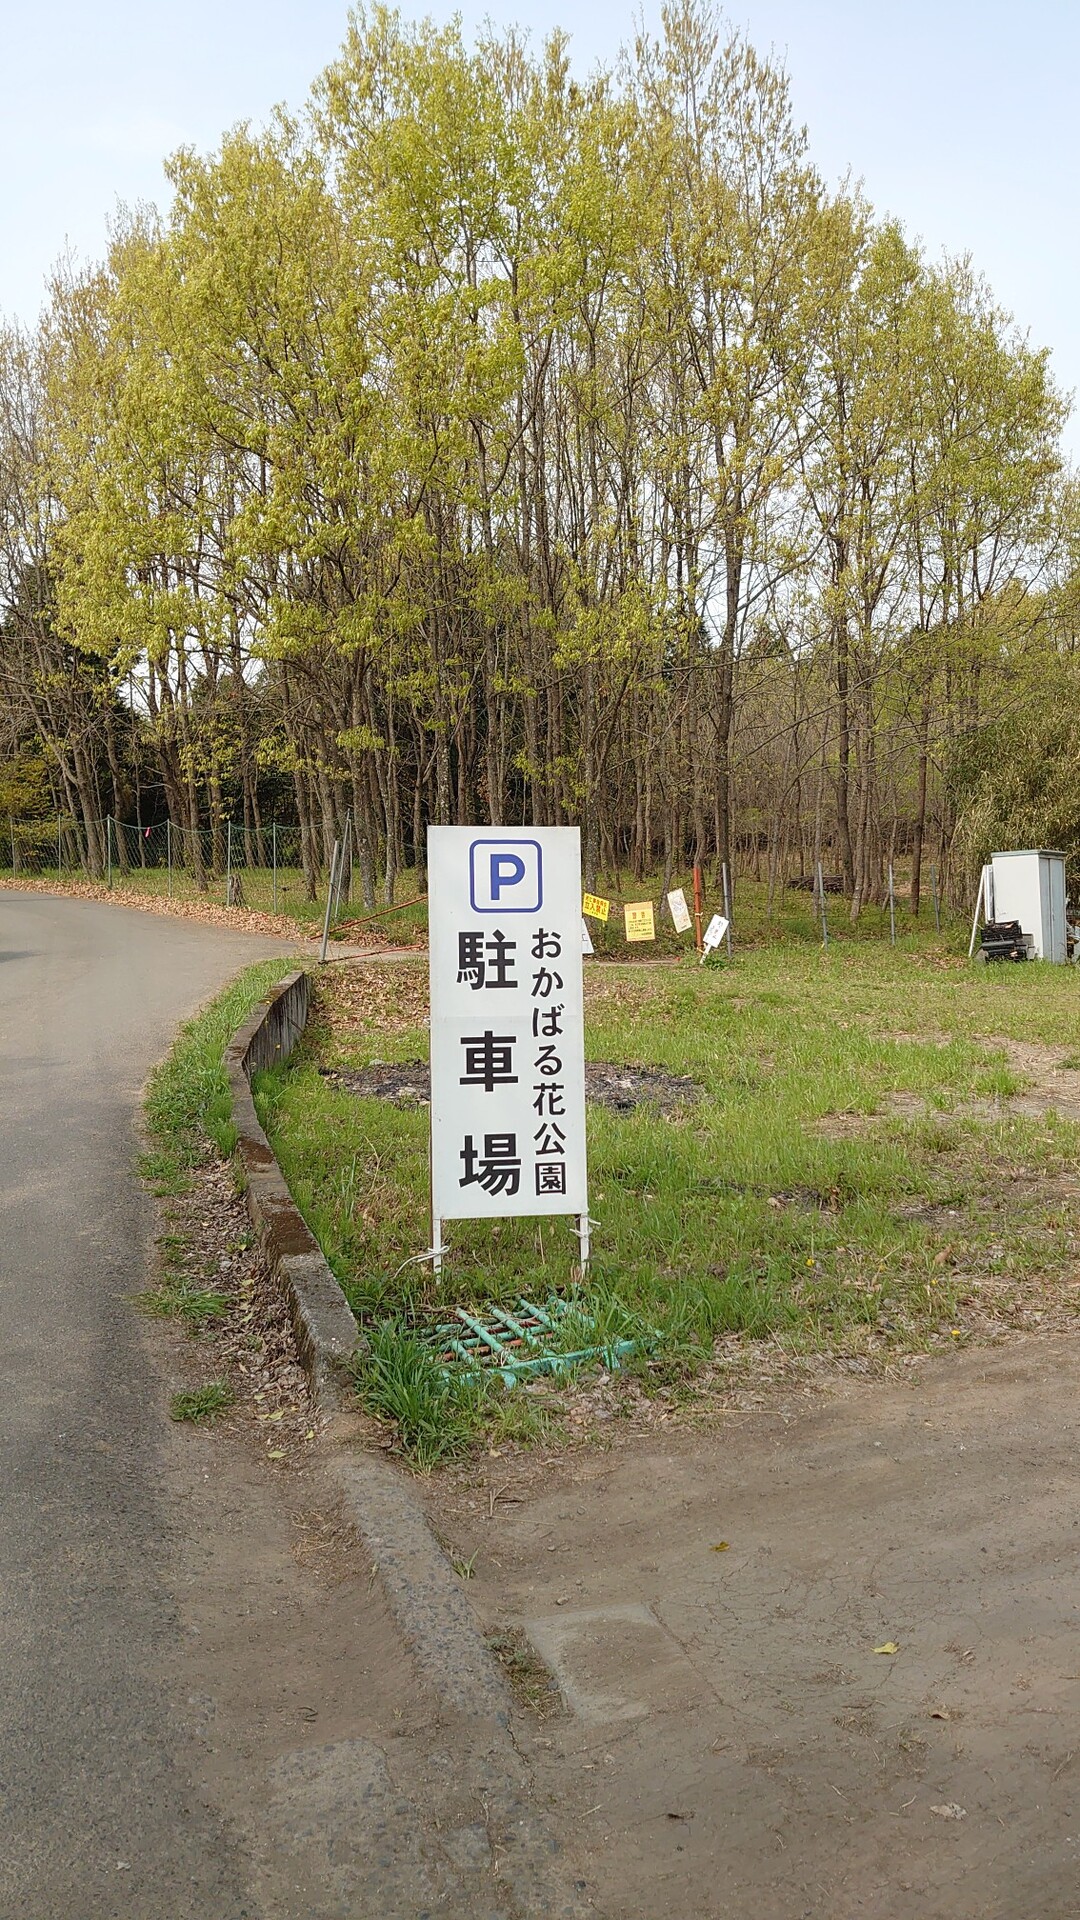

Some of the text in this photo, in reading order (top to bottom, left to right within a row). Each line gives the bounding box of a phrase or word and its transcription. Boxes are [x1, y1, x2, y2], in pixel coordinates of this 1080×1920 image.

[491, 853, 526, 901] P
[456, 931, 522, 1197] 駐車場
[531, 927, 567, 1196] おかばる花公園
